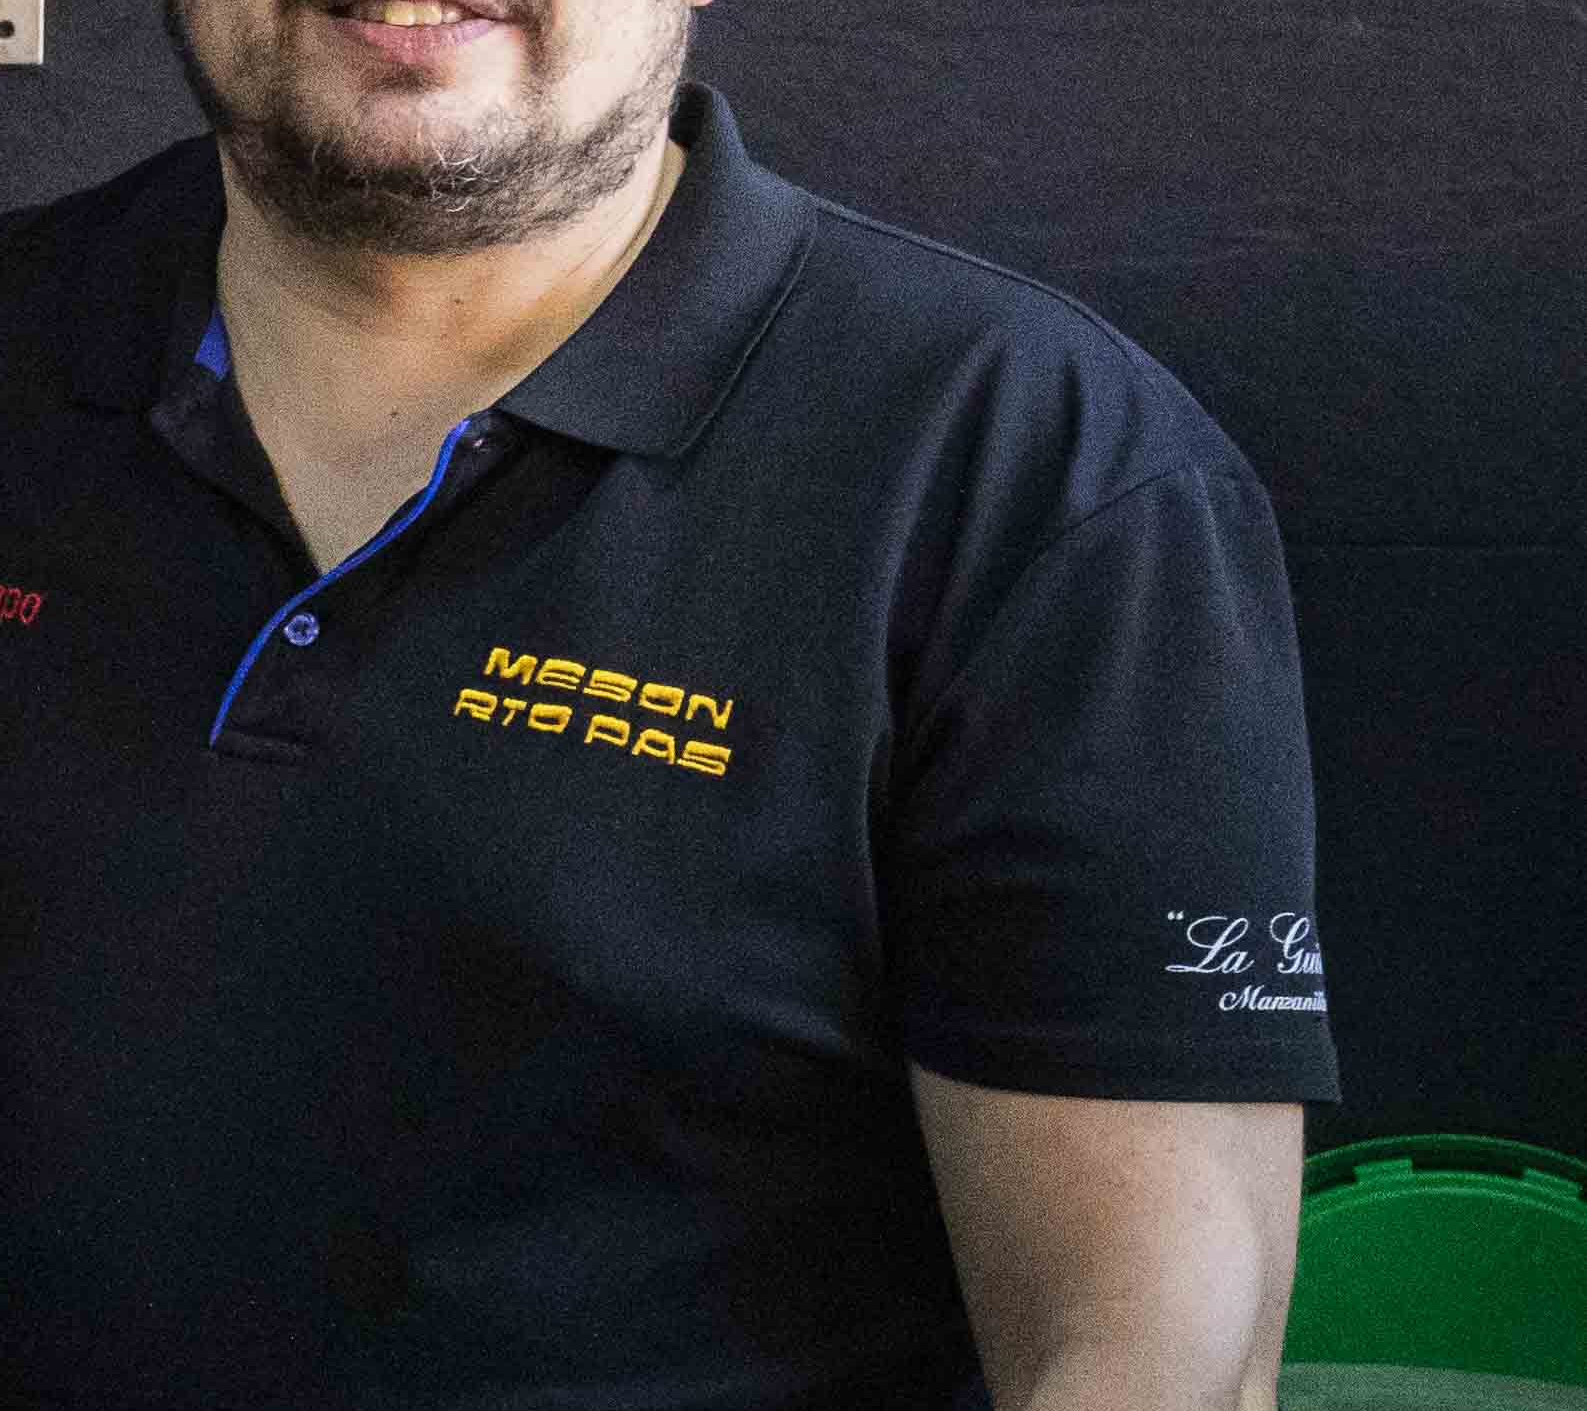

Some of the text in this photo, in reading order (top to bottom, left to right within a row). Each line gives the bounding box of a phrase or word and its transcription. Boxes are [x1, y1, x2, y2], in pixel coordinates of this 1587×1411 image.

[451, 687, 732, 777] RTO PAS
[483, 646, 734, 732] MESON
